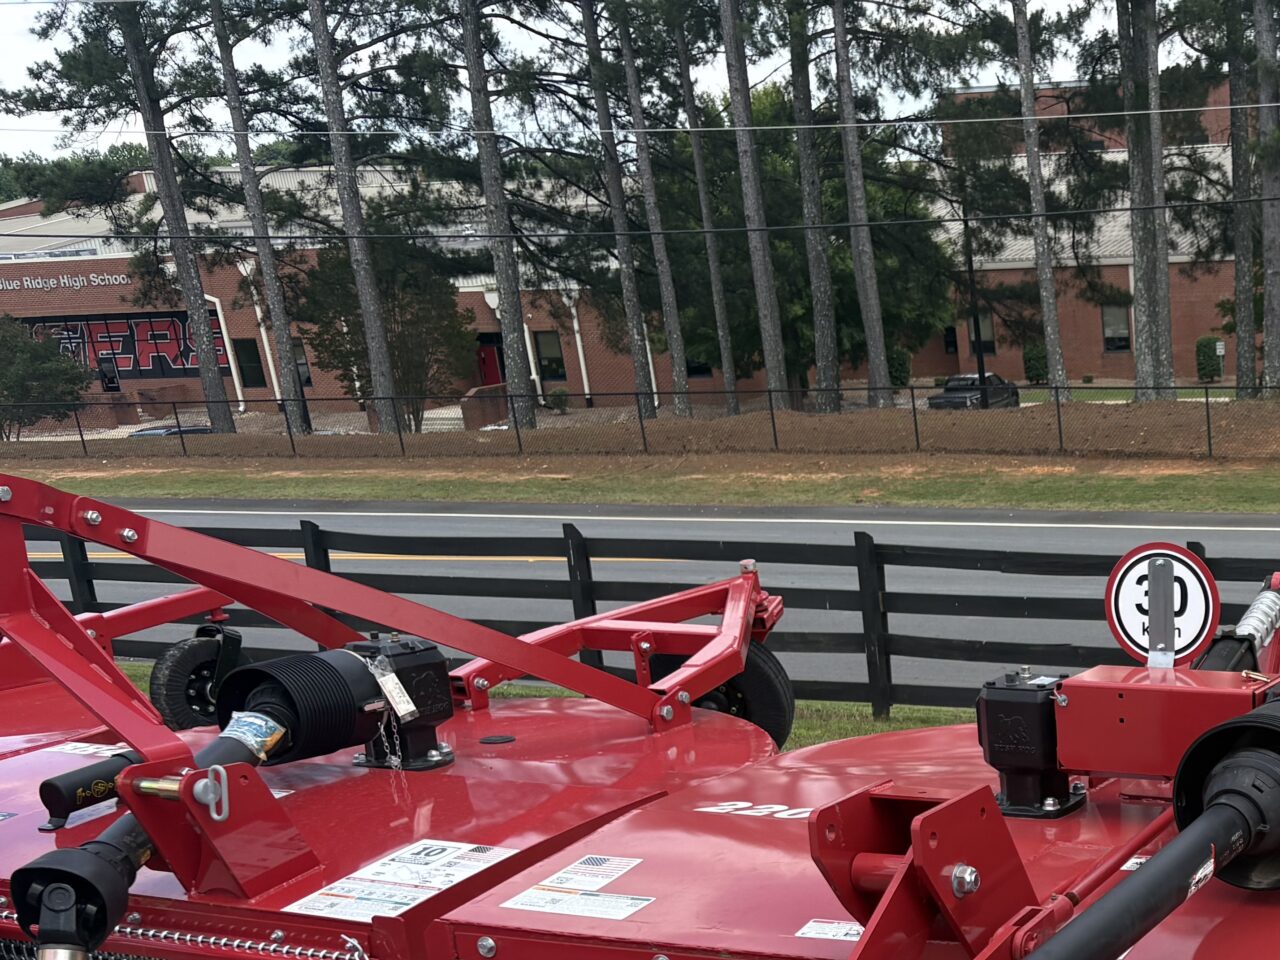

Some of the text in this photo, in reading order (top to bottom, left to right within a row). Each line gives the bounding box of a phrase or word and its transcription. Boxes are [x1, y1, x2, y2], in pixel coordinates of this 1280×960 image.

[22, 276, 58, 291] Ridge
[59, 272, 88, 290] High
[410, 846, 448, 857] 10
